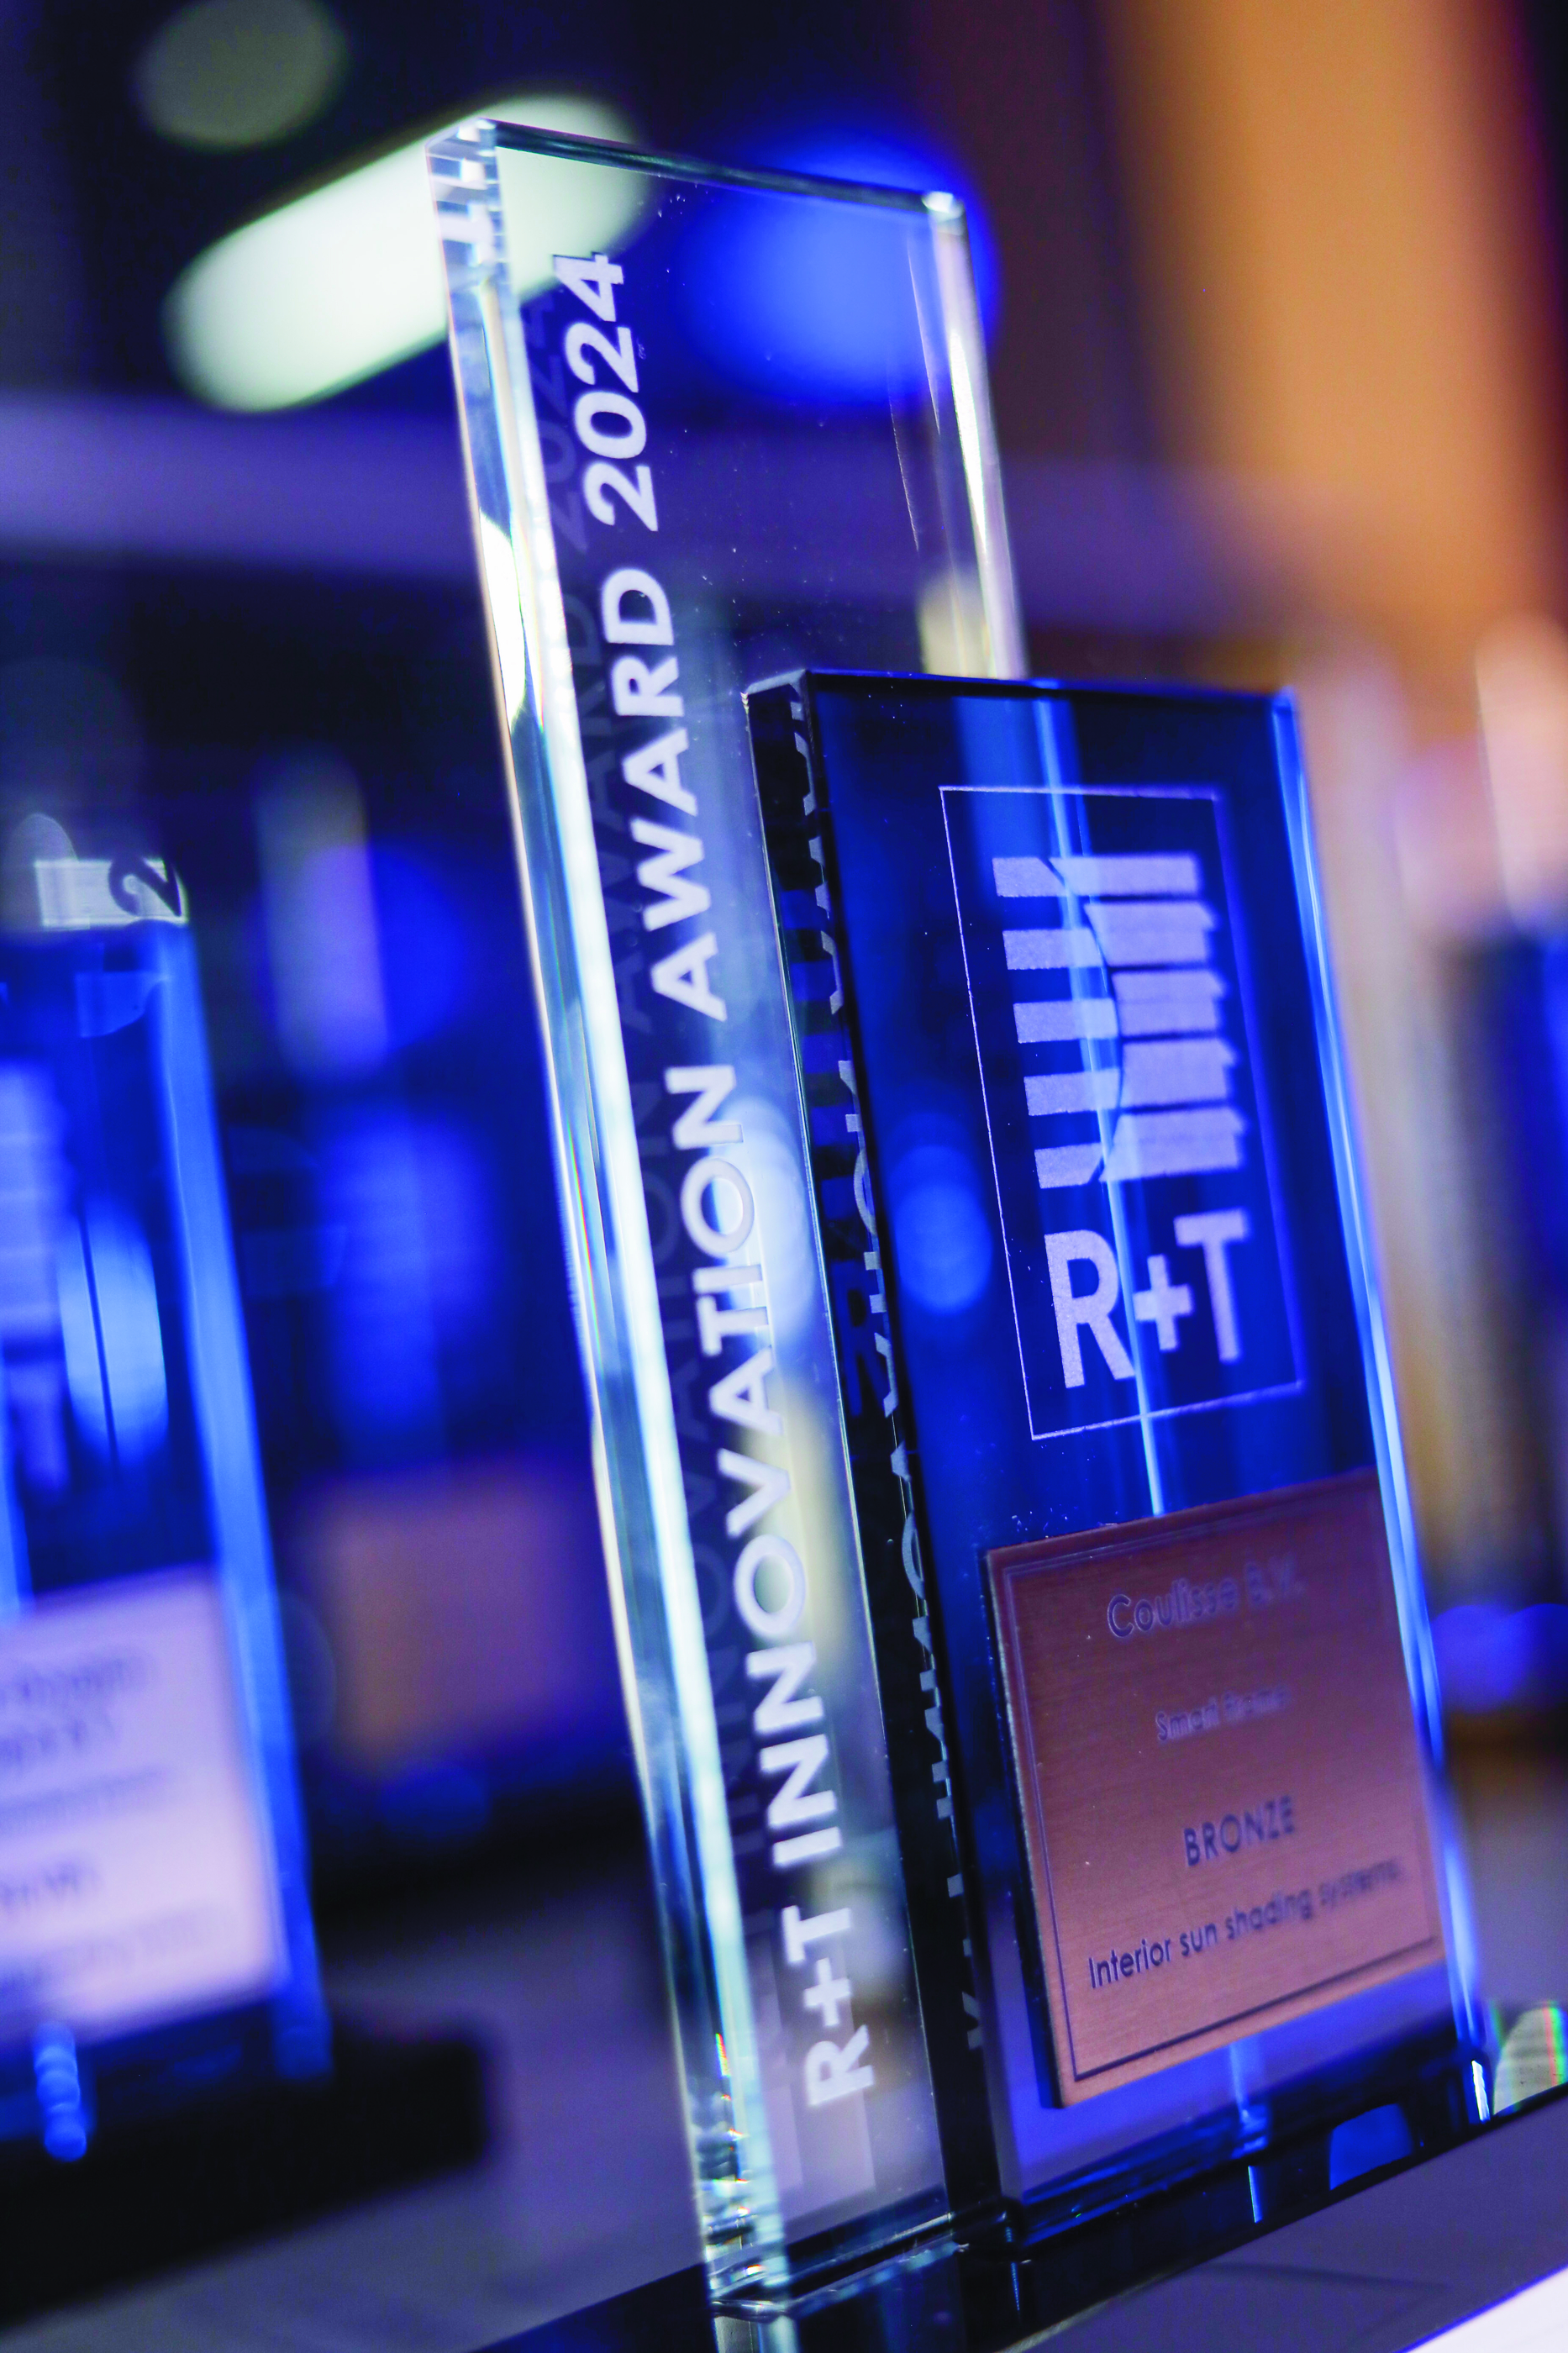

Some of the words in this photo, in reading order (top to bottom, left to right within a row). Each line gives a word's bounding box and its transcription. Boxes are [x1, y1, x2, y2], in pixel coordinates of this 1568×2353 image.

[553, 252, 659, 532] 2024
[602, 568, 727, 1022] AWARD
[1043, 1208, 1250, 1388] R+T
[663, 1065, 843, 1867] INNOVATION
[1183, 1793, 1297, 1867] BRONZE
[785, 1906, 875, 2106] R+T
[1088, 1936, 1172, 1989] Interior
[1179, 1921, 1218, 1958] sun
[1224, 1888, 1314, 1940] shading
